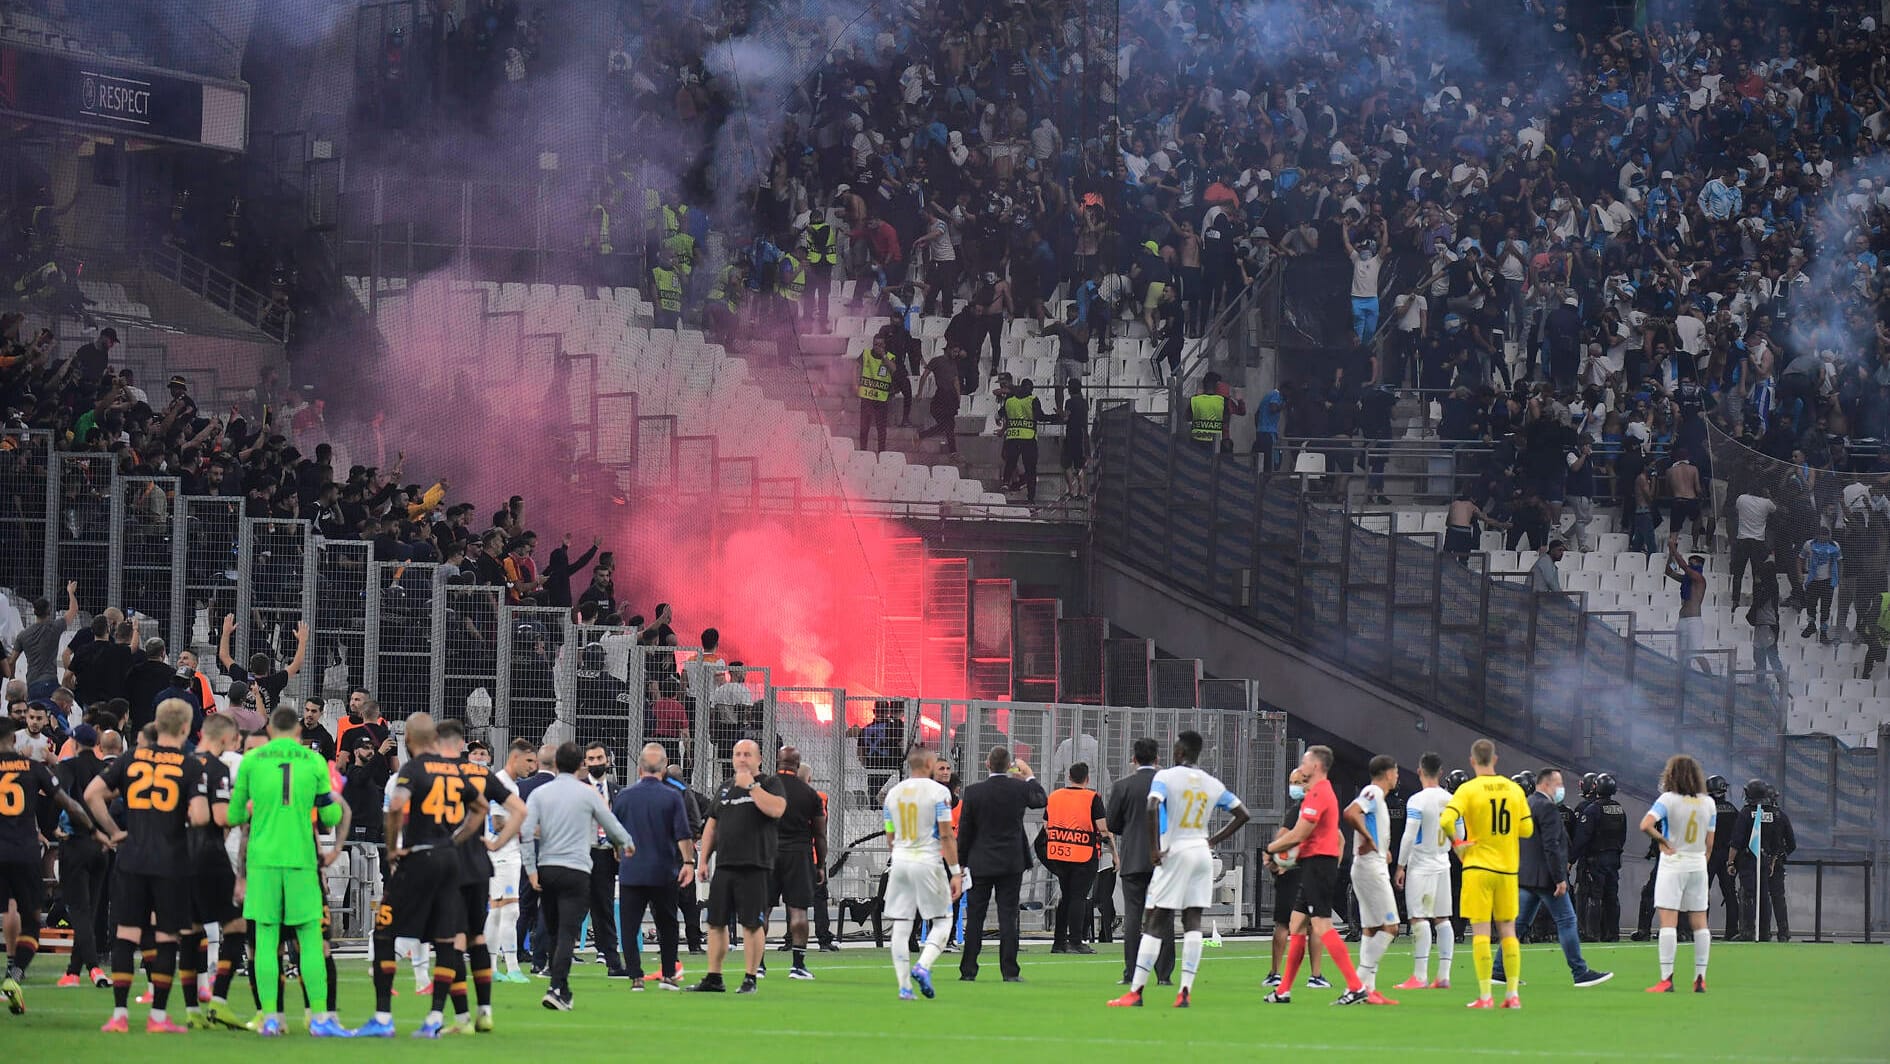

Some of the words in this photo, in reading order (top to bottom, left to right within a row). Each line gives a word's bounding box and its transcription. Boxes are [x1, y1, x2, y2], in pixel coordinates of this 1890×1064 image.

[99, 84, 150, 115] RESPECT
[0, 771, 26, 816] 6
[126, 760, 184, 812] 25
[278, 762, 293, 806] 1
[421, 775, 465, 824] 45
[897, 801, 919, 841] 10
[1179, 789, 1209, 829] 22
[1490, 797, 1511, 836] 16
[1684, 809, 1699, 845] 6
[1049, 844, 1072, 857] 053
